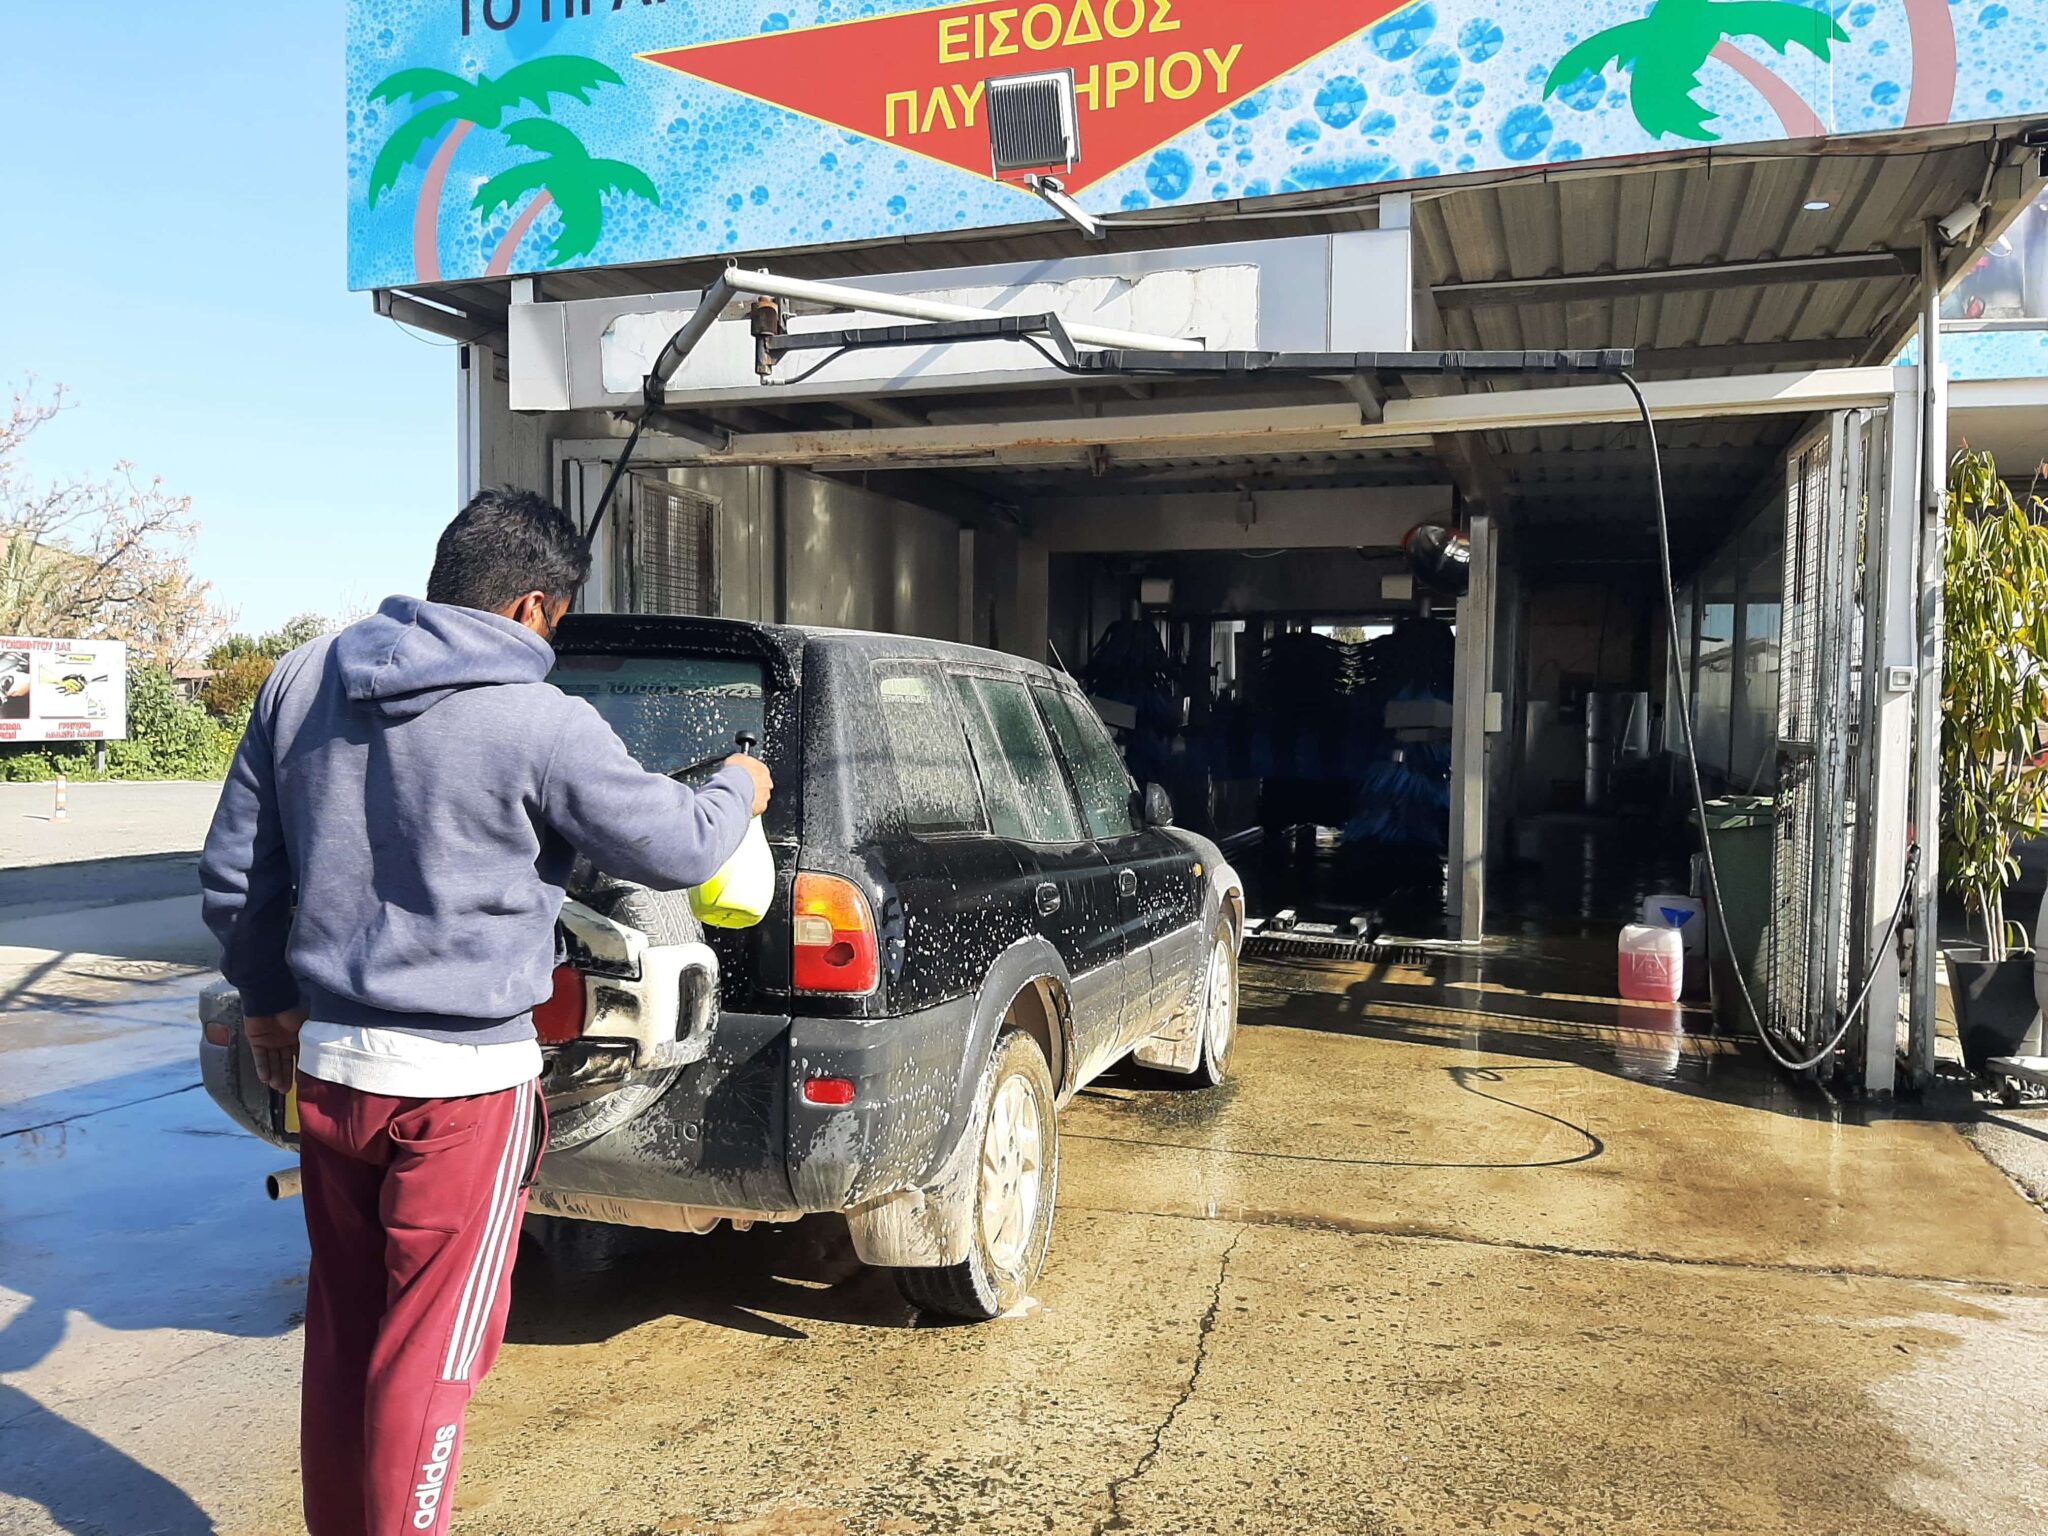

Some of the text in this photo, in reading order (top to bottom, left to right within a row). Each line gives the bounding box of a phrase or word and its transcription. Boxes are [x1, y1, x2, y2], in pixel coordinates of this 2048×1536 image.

[937, 0, 1181, 64] ΕΙΣΟΔΟΣ
[885, 44, 1243, 137] ΠΛΥΗΡΙΟΥ
[607, 681, 671, 695] TOYOTA
[413, 1424, 457, 1530] adidas
